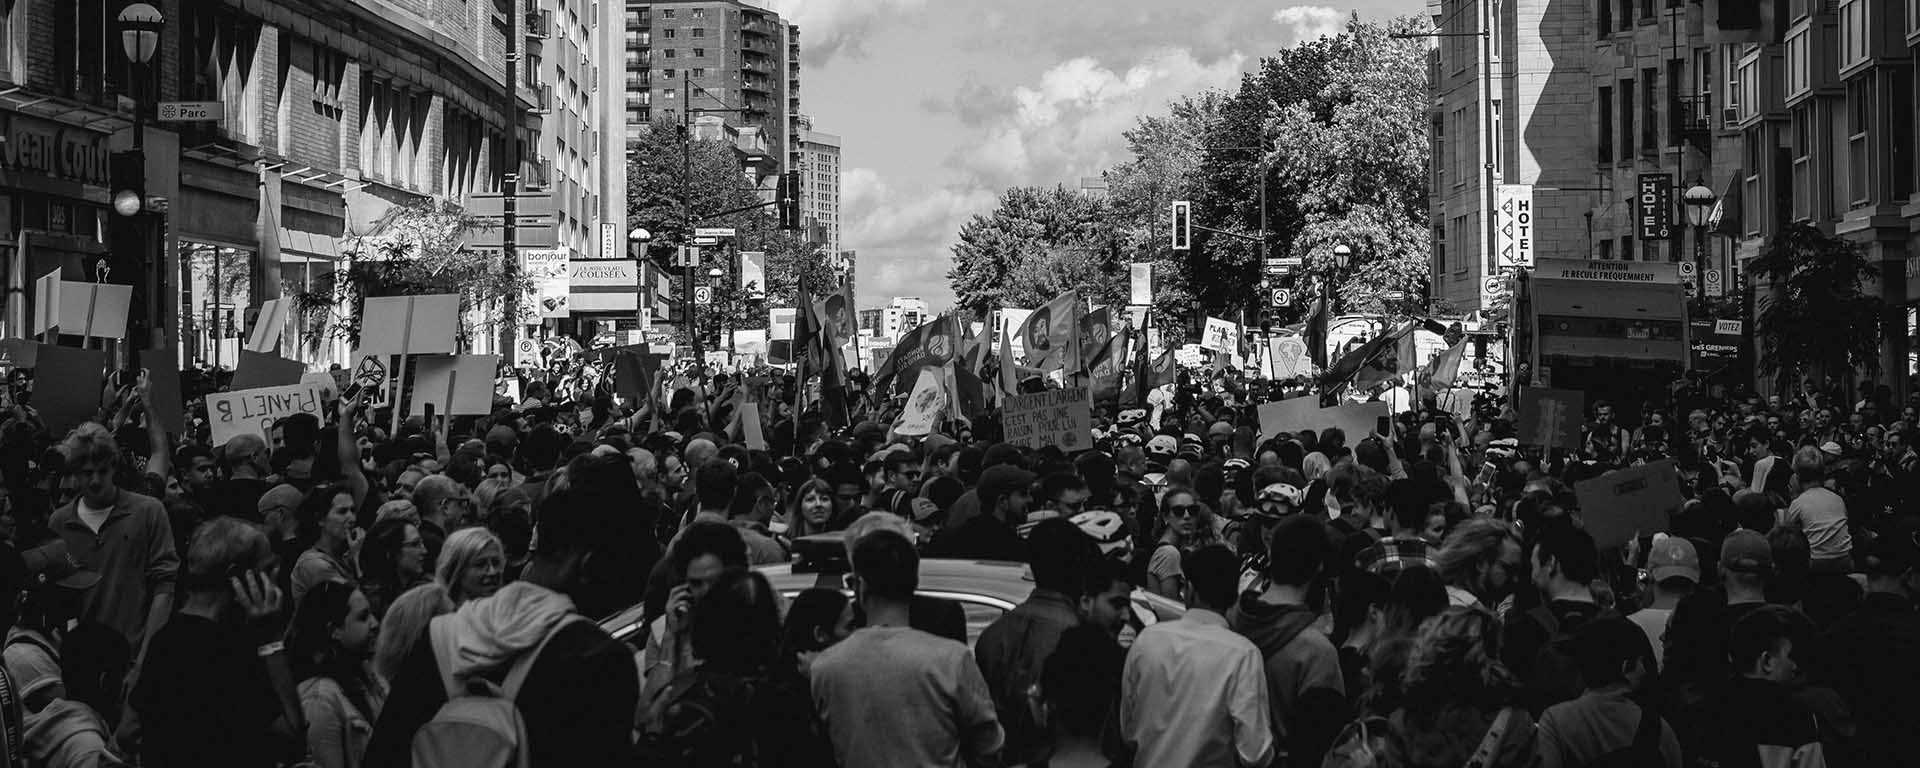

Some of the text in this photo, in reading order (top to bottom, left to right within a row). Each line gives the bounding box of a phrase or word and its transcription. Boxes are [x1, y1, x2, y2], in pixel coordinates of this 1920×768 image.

[180, 108, 207, 118] Parc
[4, 116, 56, 173] Jean
[1518, 200, 1530, 263] HOTEL
[527, 252, 567, 262] bonjour
[1588, 262, 1629, 271] ATTENTION
[1561, 270, 1655, 281] JE RECULE FRÉQUEMMENT
[1718, 322, 1740, 332] VOTEZ
[216, 388, 317, 423] PLANET B
[1032, 409, 1048, 422] PAS
